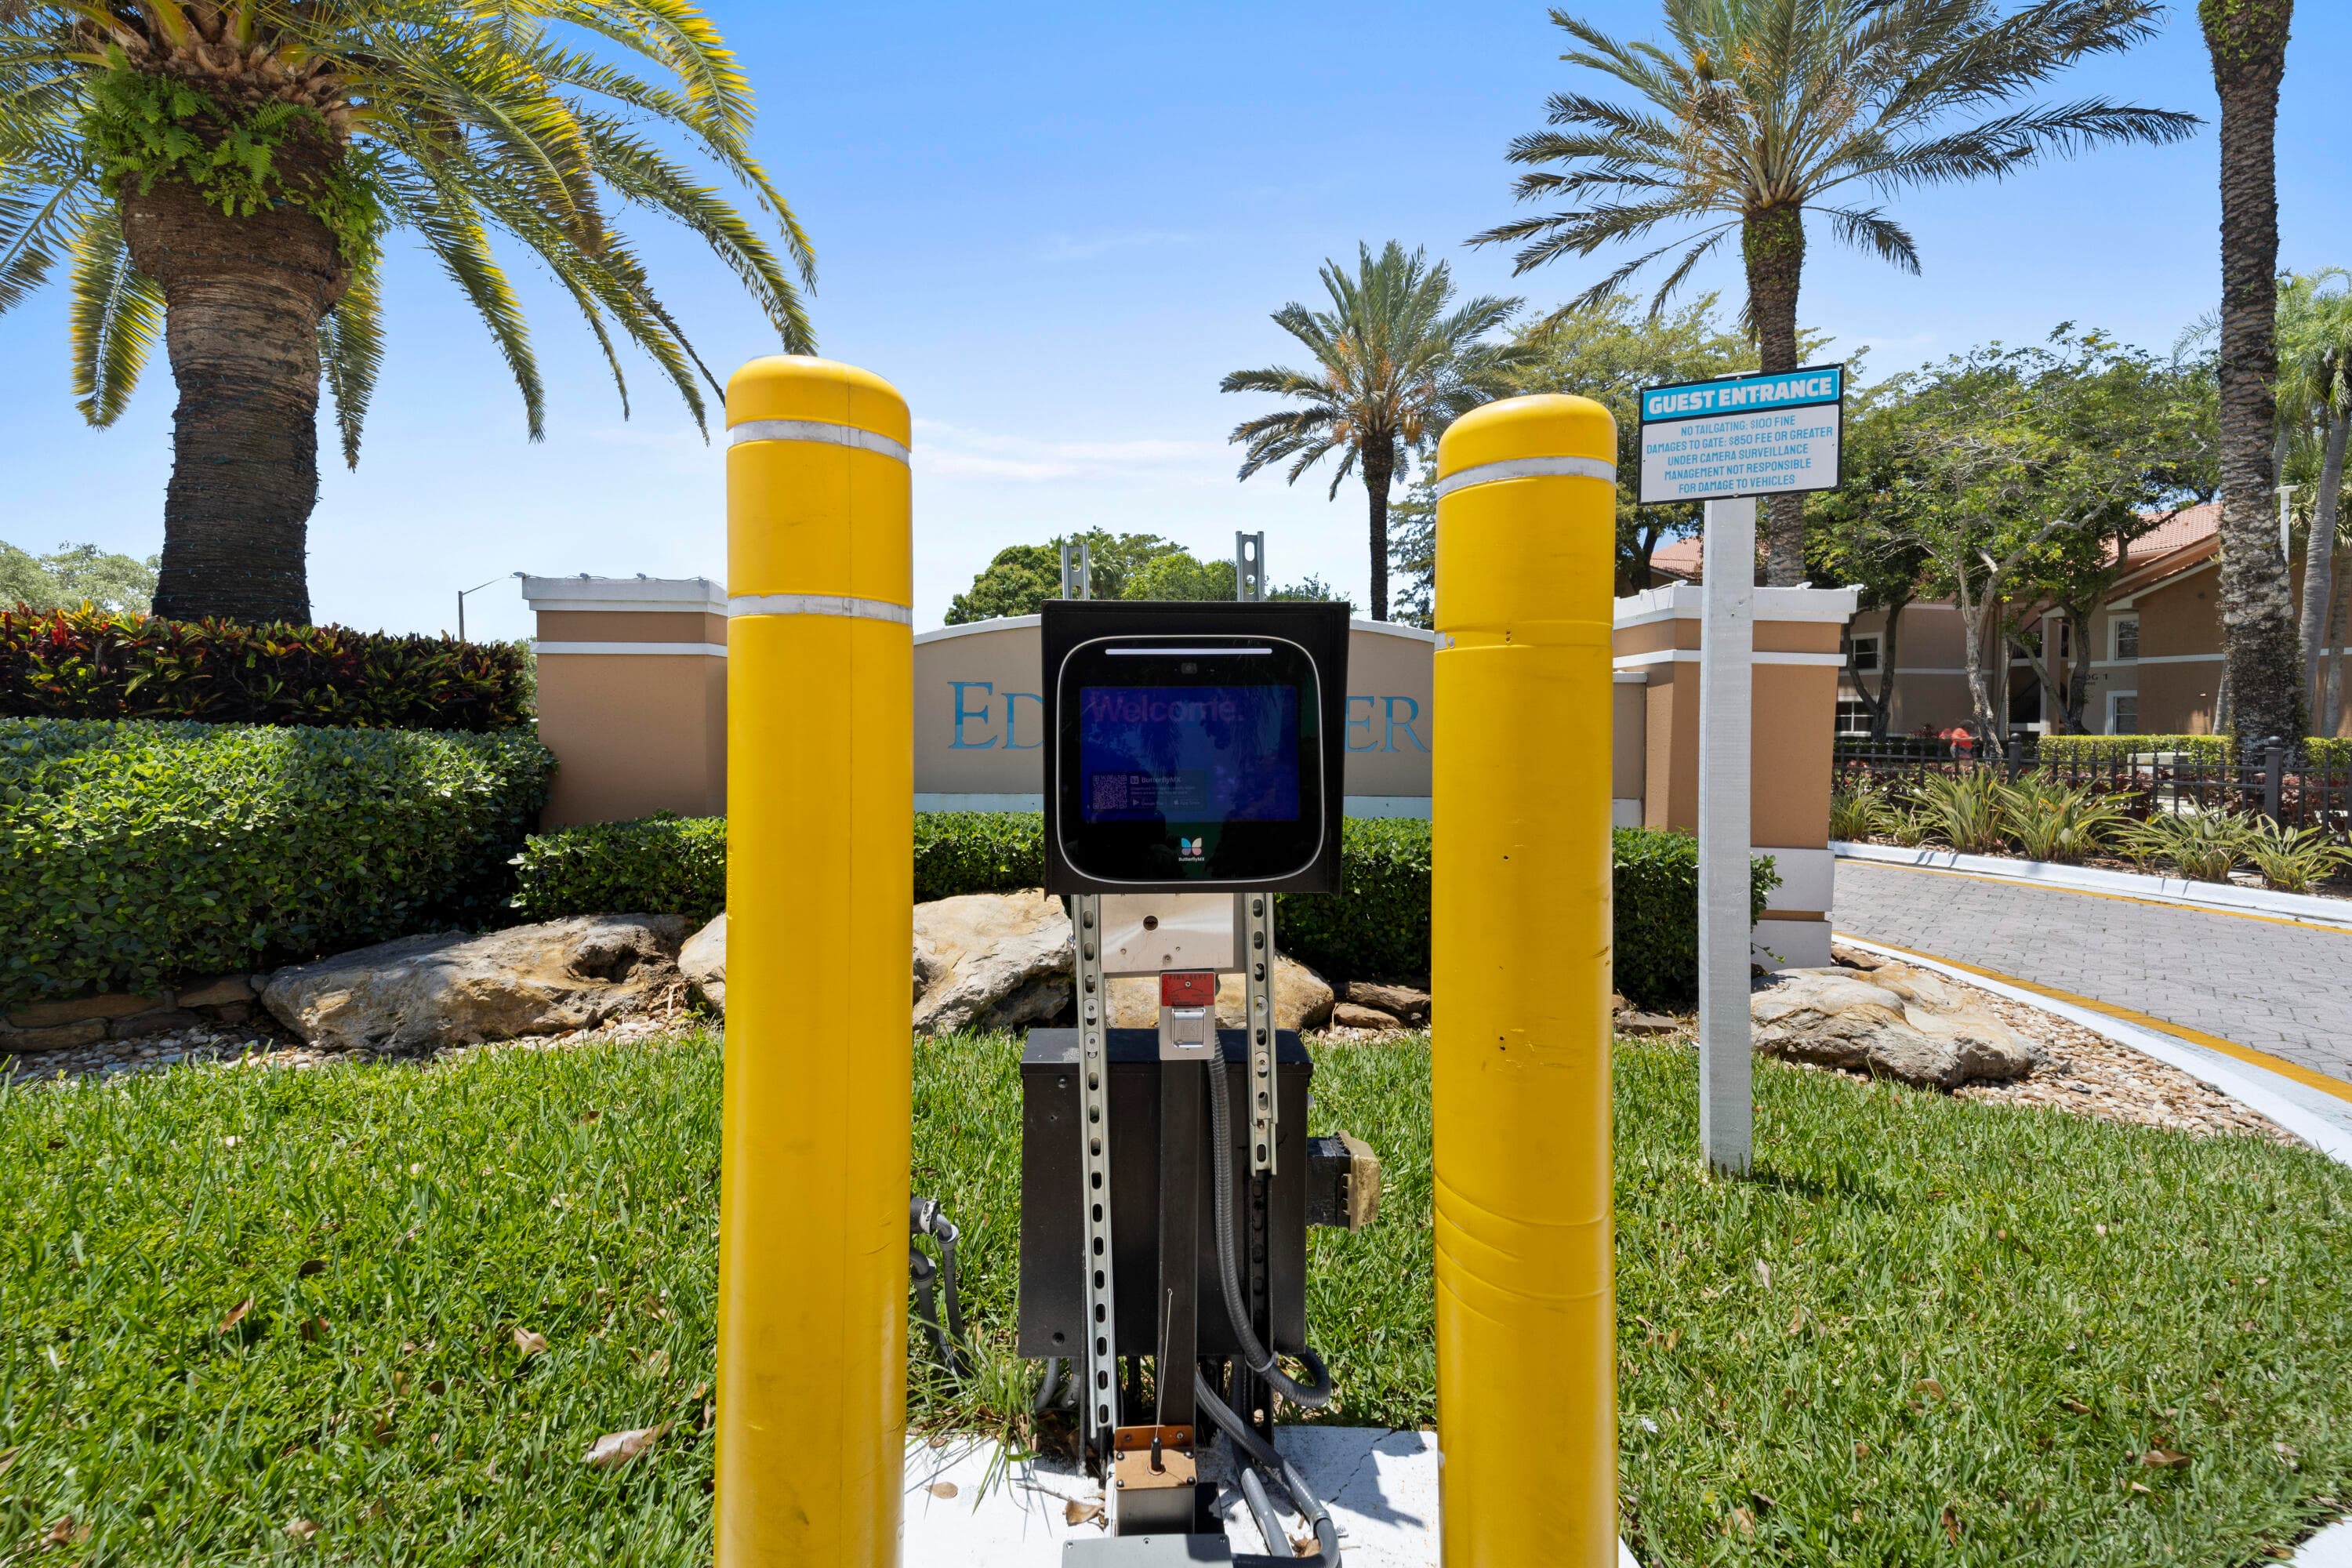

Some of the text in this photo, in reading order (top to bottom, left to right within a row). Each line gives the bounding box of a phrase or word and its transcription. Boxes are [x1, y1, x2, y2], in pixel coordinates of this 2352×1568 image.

[1649, 377, 1832, 415] GUEST ENTRANCE
[1681, 416, 1795, 437] NO TAILGATING: $100 FINE
[1647, 426, 1832, 454] DAMAGES TO GATE: $850 FEE OR GREATER
[1668, 444, 1808, 466] UNDER CAMERA SURVEILLANCE
[1664, 459, 1811, 481] MANAGEMENT NOT RESPONSIBLE
[1679, 474, 1795, 494] FOR DAMAGE TO VEHICLES
